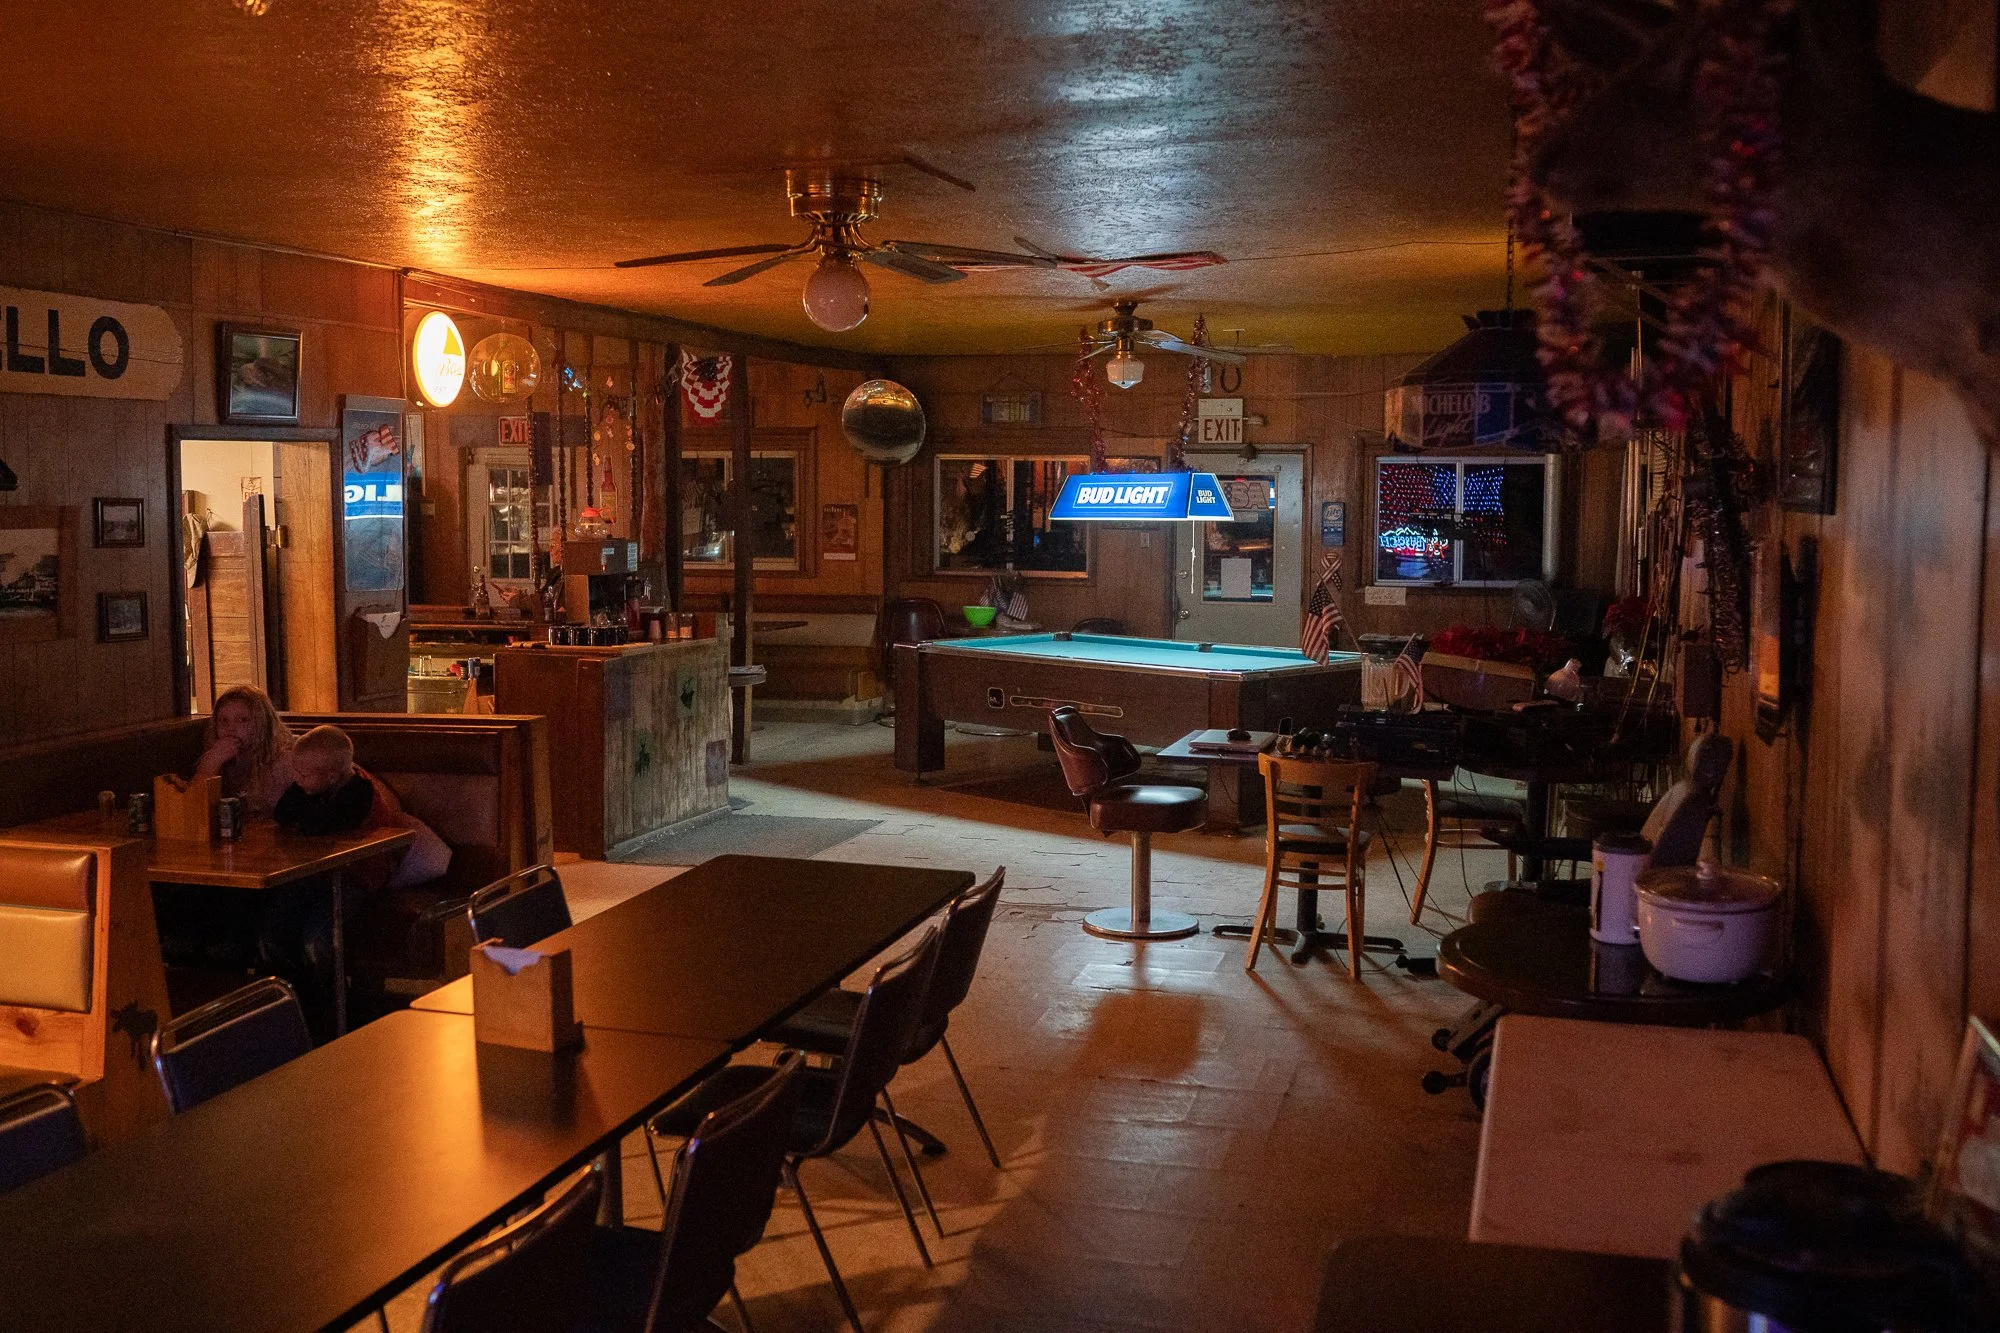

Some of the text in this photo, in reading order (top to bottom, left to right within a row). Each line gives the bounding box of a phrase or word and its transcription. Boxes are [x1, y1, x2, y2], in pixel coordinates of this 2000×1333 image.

[0, 304, 129, 380] LLO
[1204, 418, 1241, 441] EXIT
[1076, 485, 1169, 505] BUD LIGHT
[1196, 496, 1216, 504] LIGHT
[1197, 489, 1213, 498] BUD
